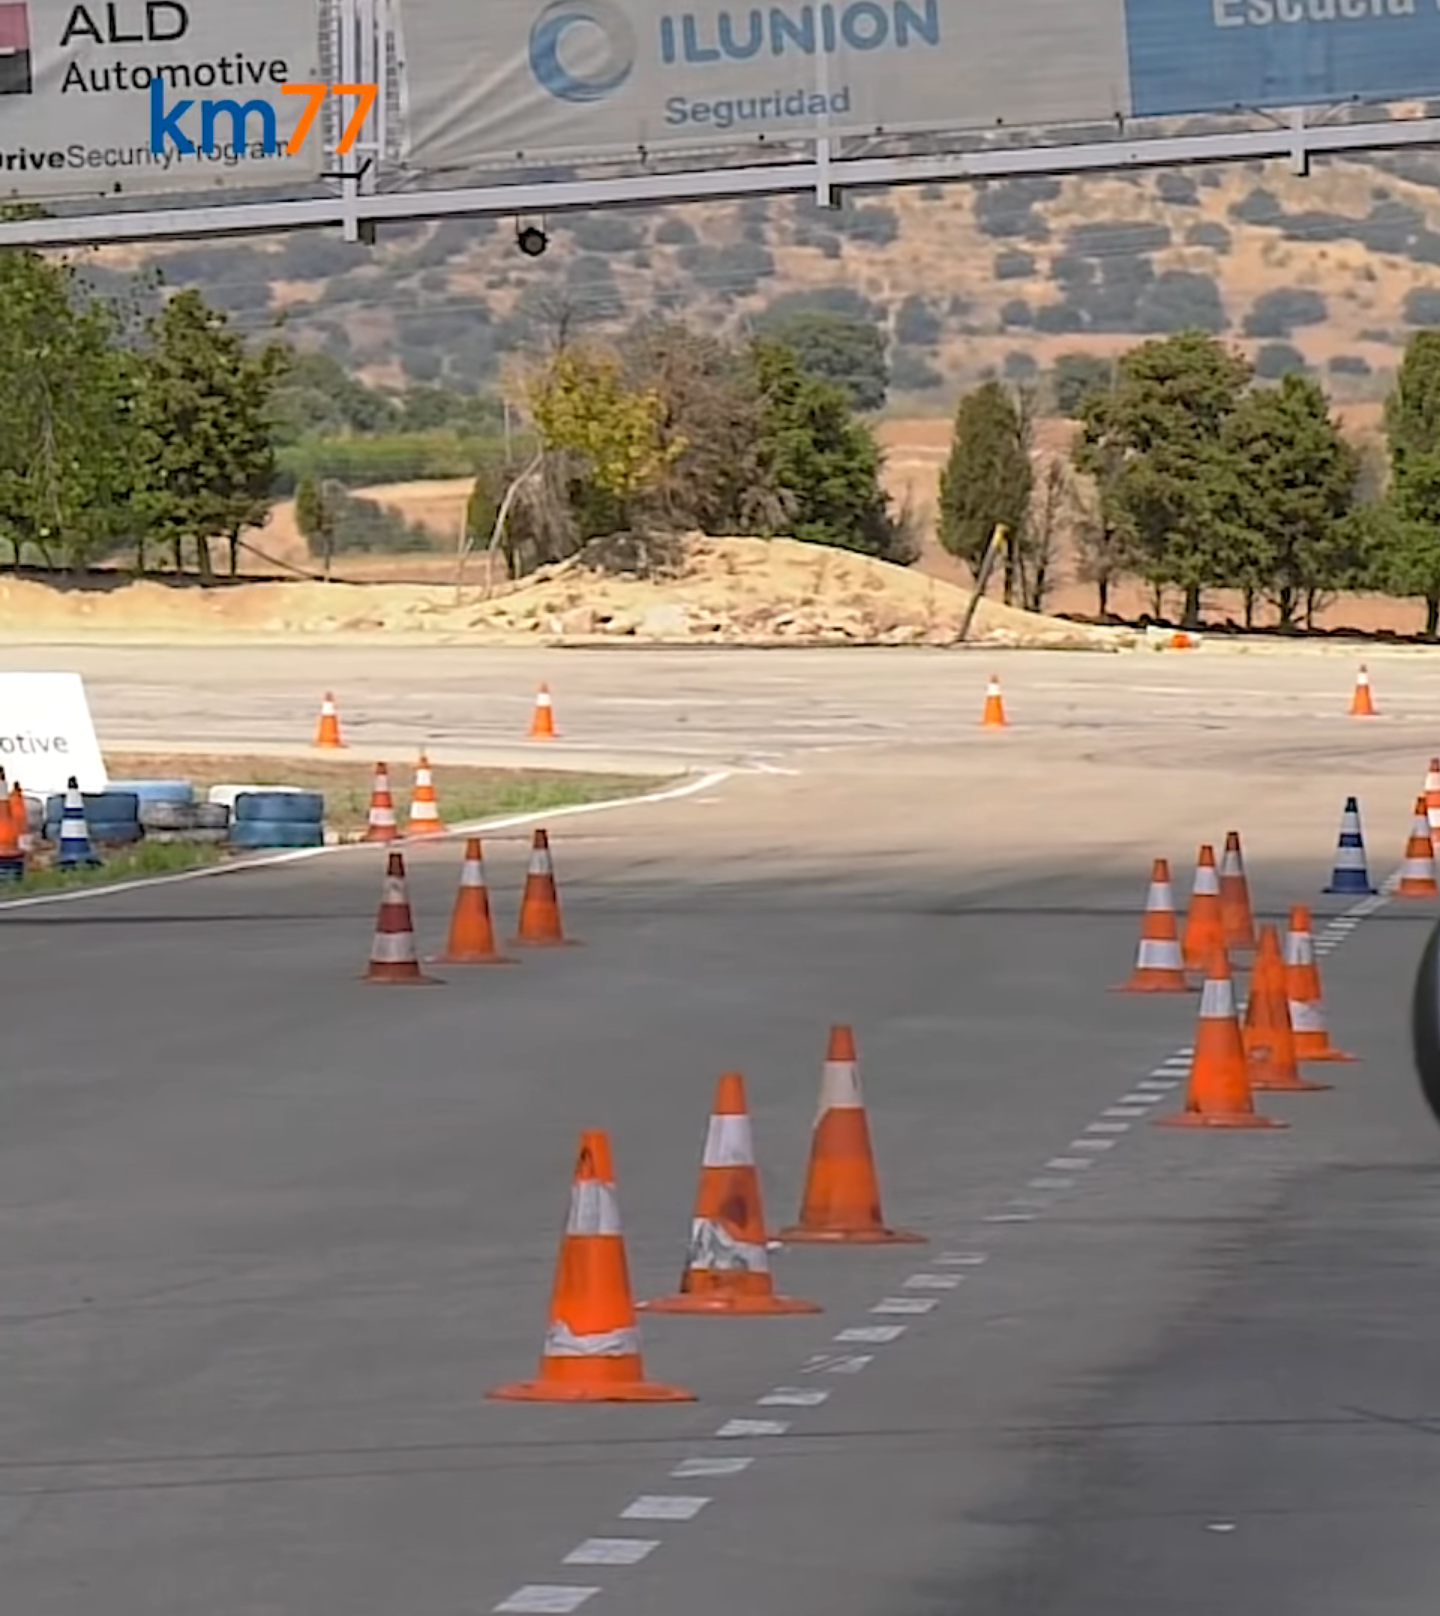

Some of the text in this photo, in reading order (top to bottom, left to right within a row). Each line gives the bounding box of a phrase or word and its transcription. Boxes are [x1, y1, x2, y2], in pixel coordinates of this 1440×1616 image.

[60, 1, 189, 46] ALD
[660, 0, 940, 64] ILUNION
[61, 53, 289, 94] Automotive
[665, 87, 850, 128] Seguridad
